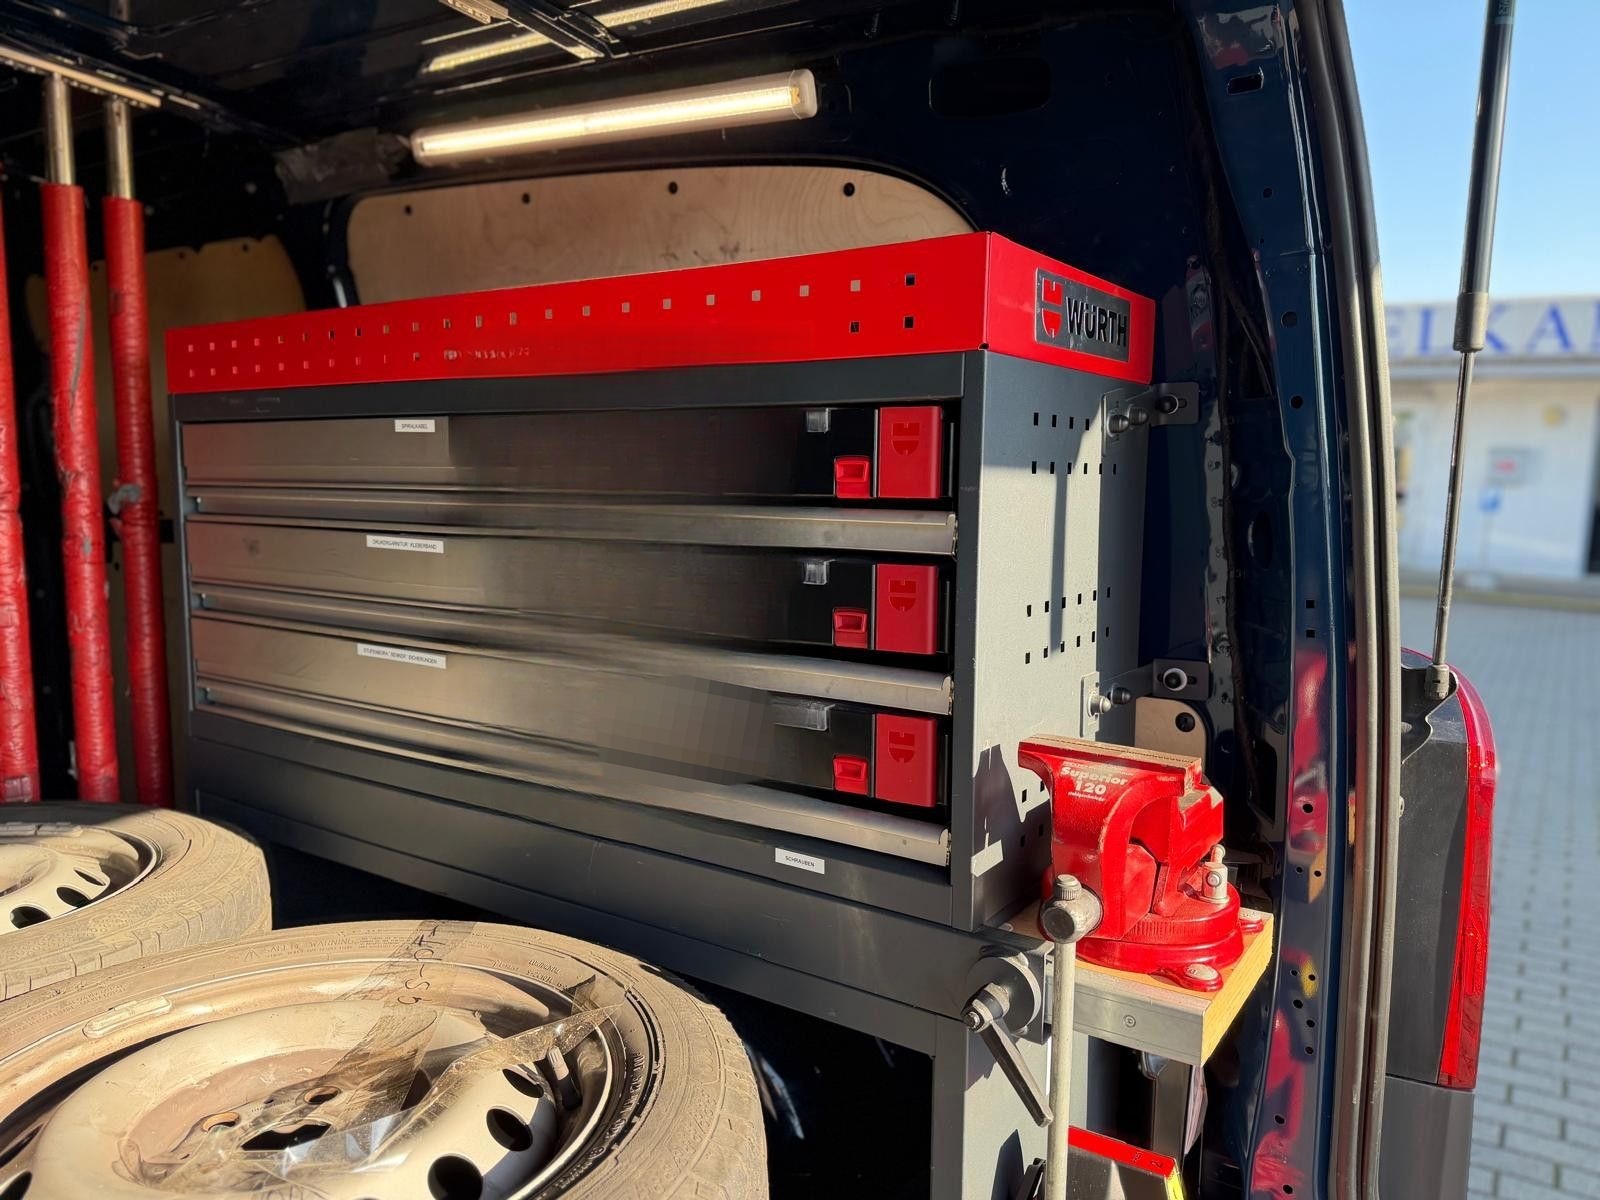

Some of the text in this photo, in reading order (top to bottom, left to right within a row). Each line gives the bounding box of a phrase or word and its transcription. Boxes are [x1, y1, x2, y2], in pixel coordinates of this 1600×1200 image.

[1066, 296, 1127, 347] WÜRTH
[1061, 766, 1128, 785] Superior
[1075, 780, 1107, 795] 120
[785, 856, 815, 867] SCHRAUBEN
